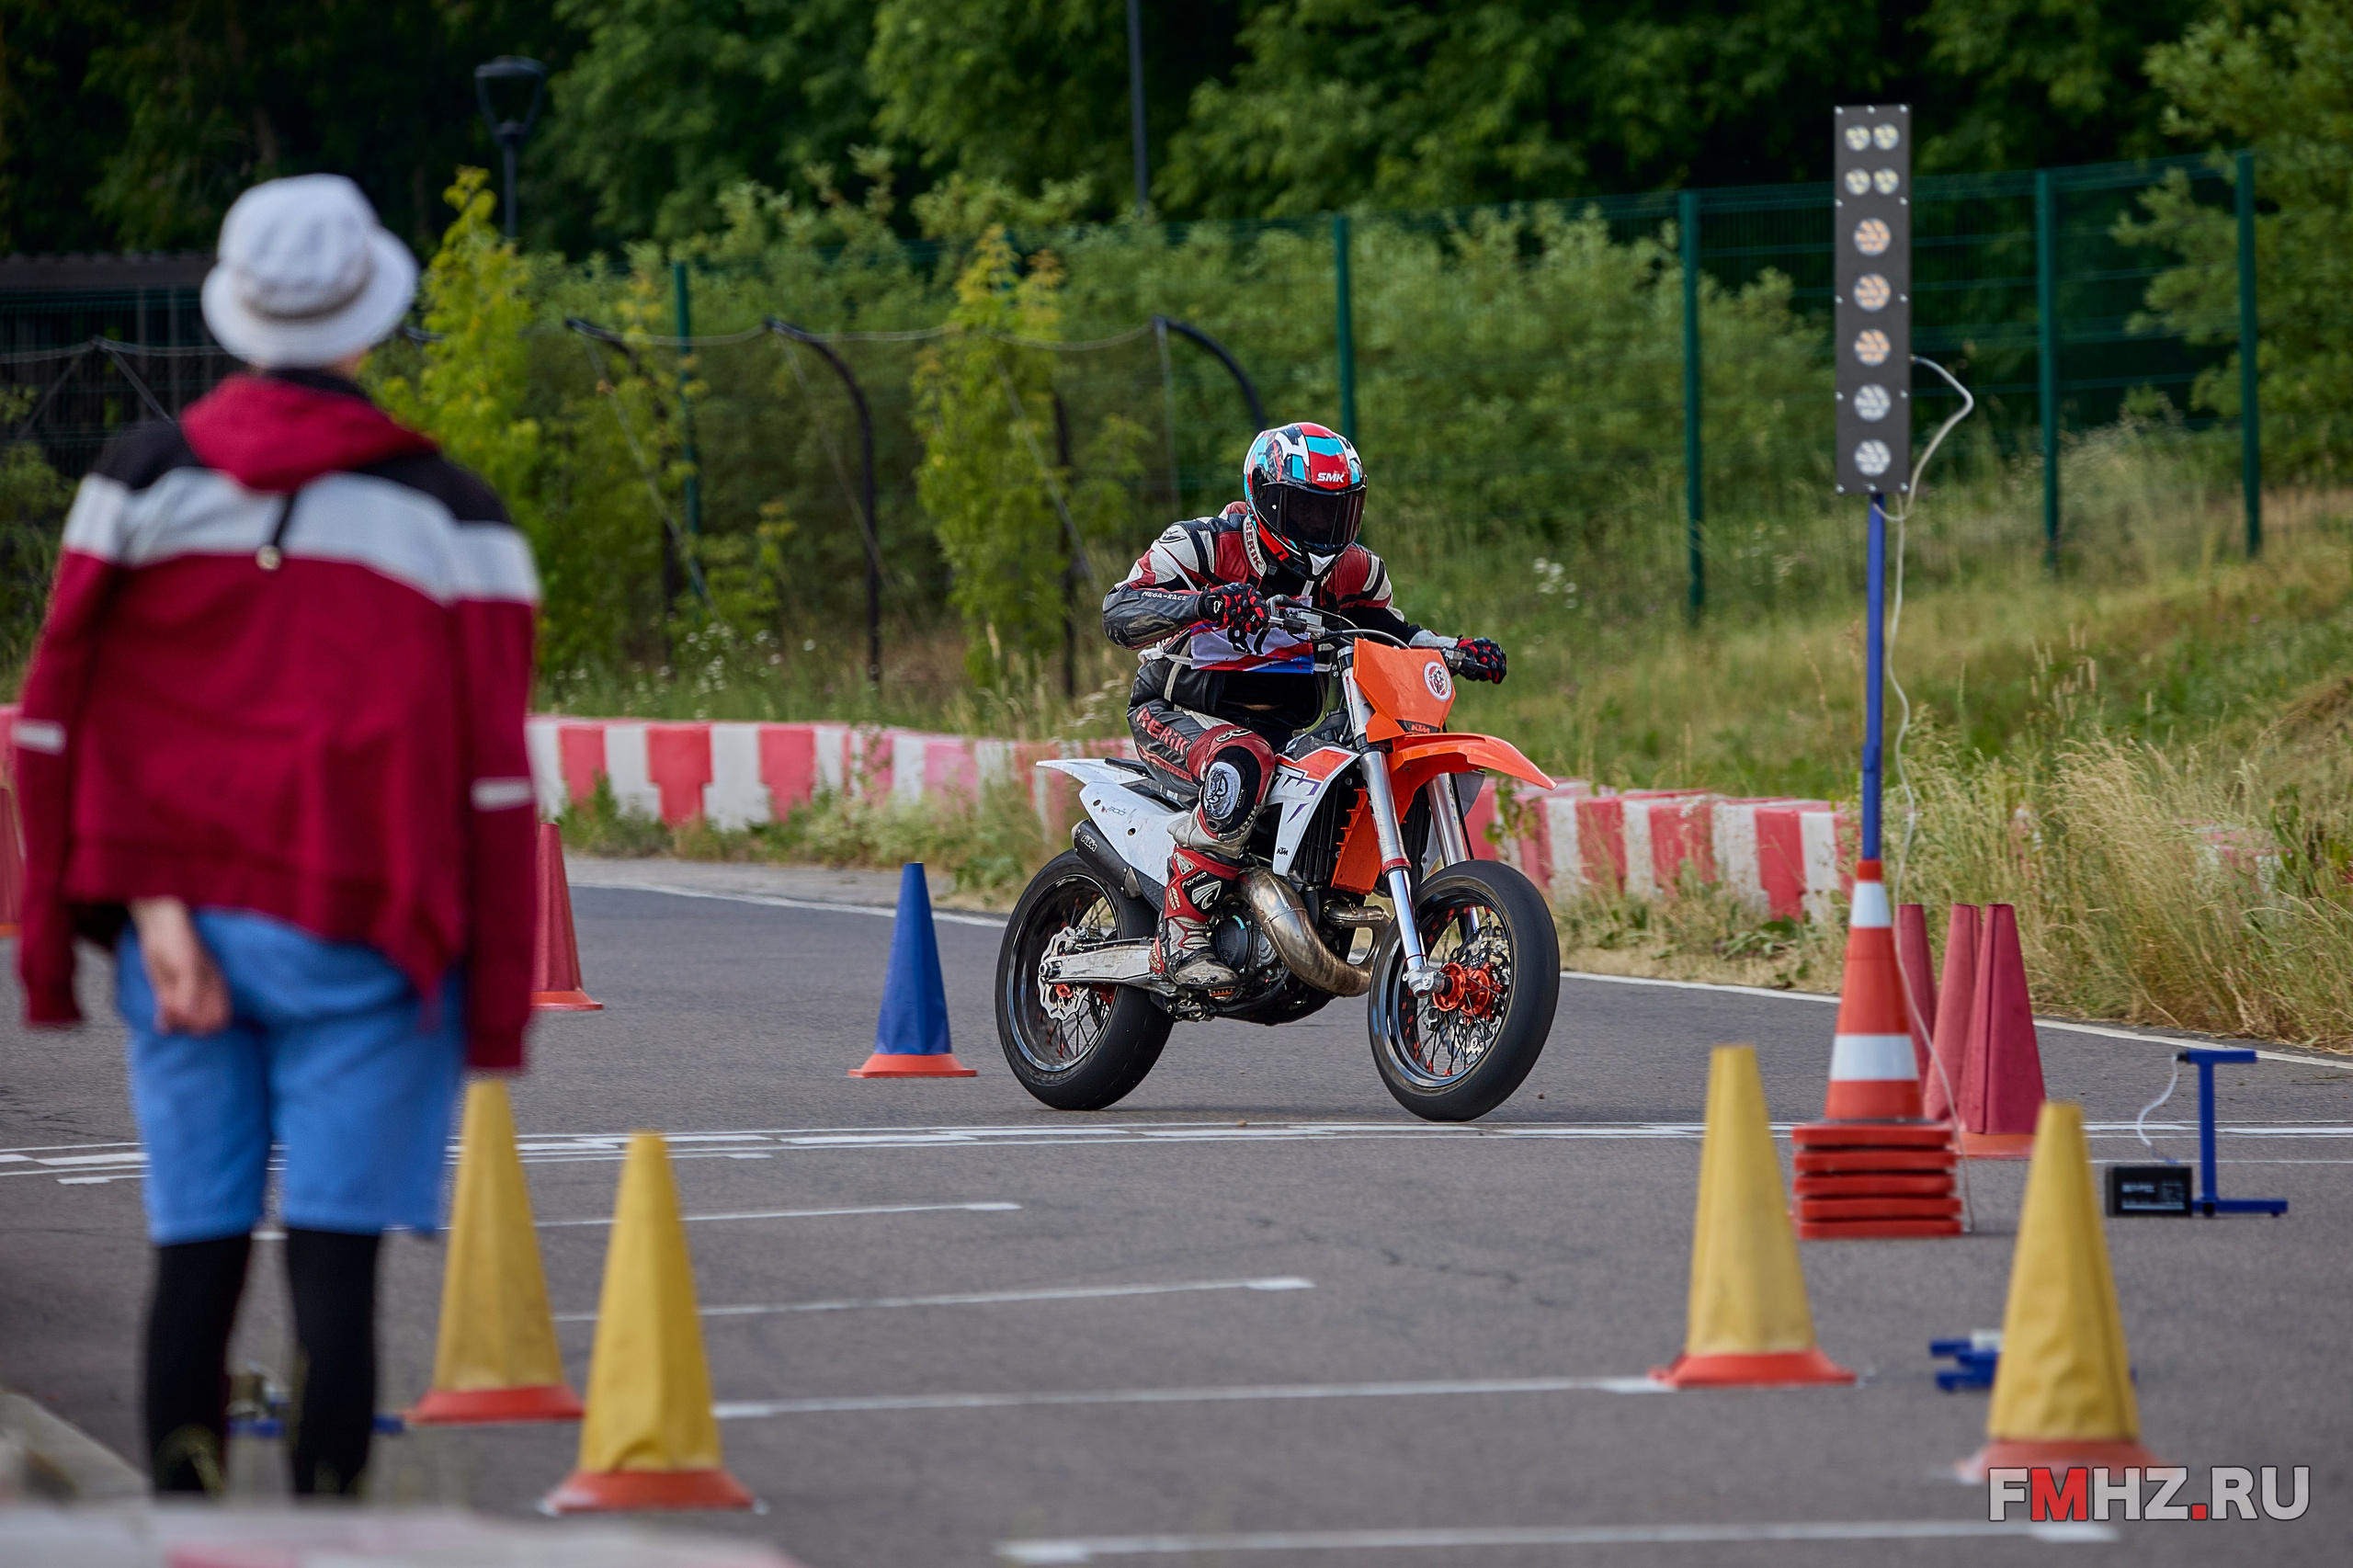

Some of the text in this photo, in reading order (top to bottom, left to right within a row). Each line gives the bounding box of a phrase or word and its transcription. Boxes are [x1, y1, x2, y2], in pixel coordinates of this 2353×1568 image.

[1316, 472, 1346, 483] SMK
[1141, 591, 1188, 601] MEGA-RACE
[1411, 723, 1430, 733] KTM
[1080, 835, 1097, 853] KTM
[1276, 846, 1289, 857] KTM
